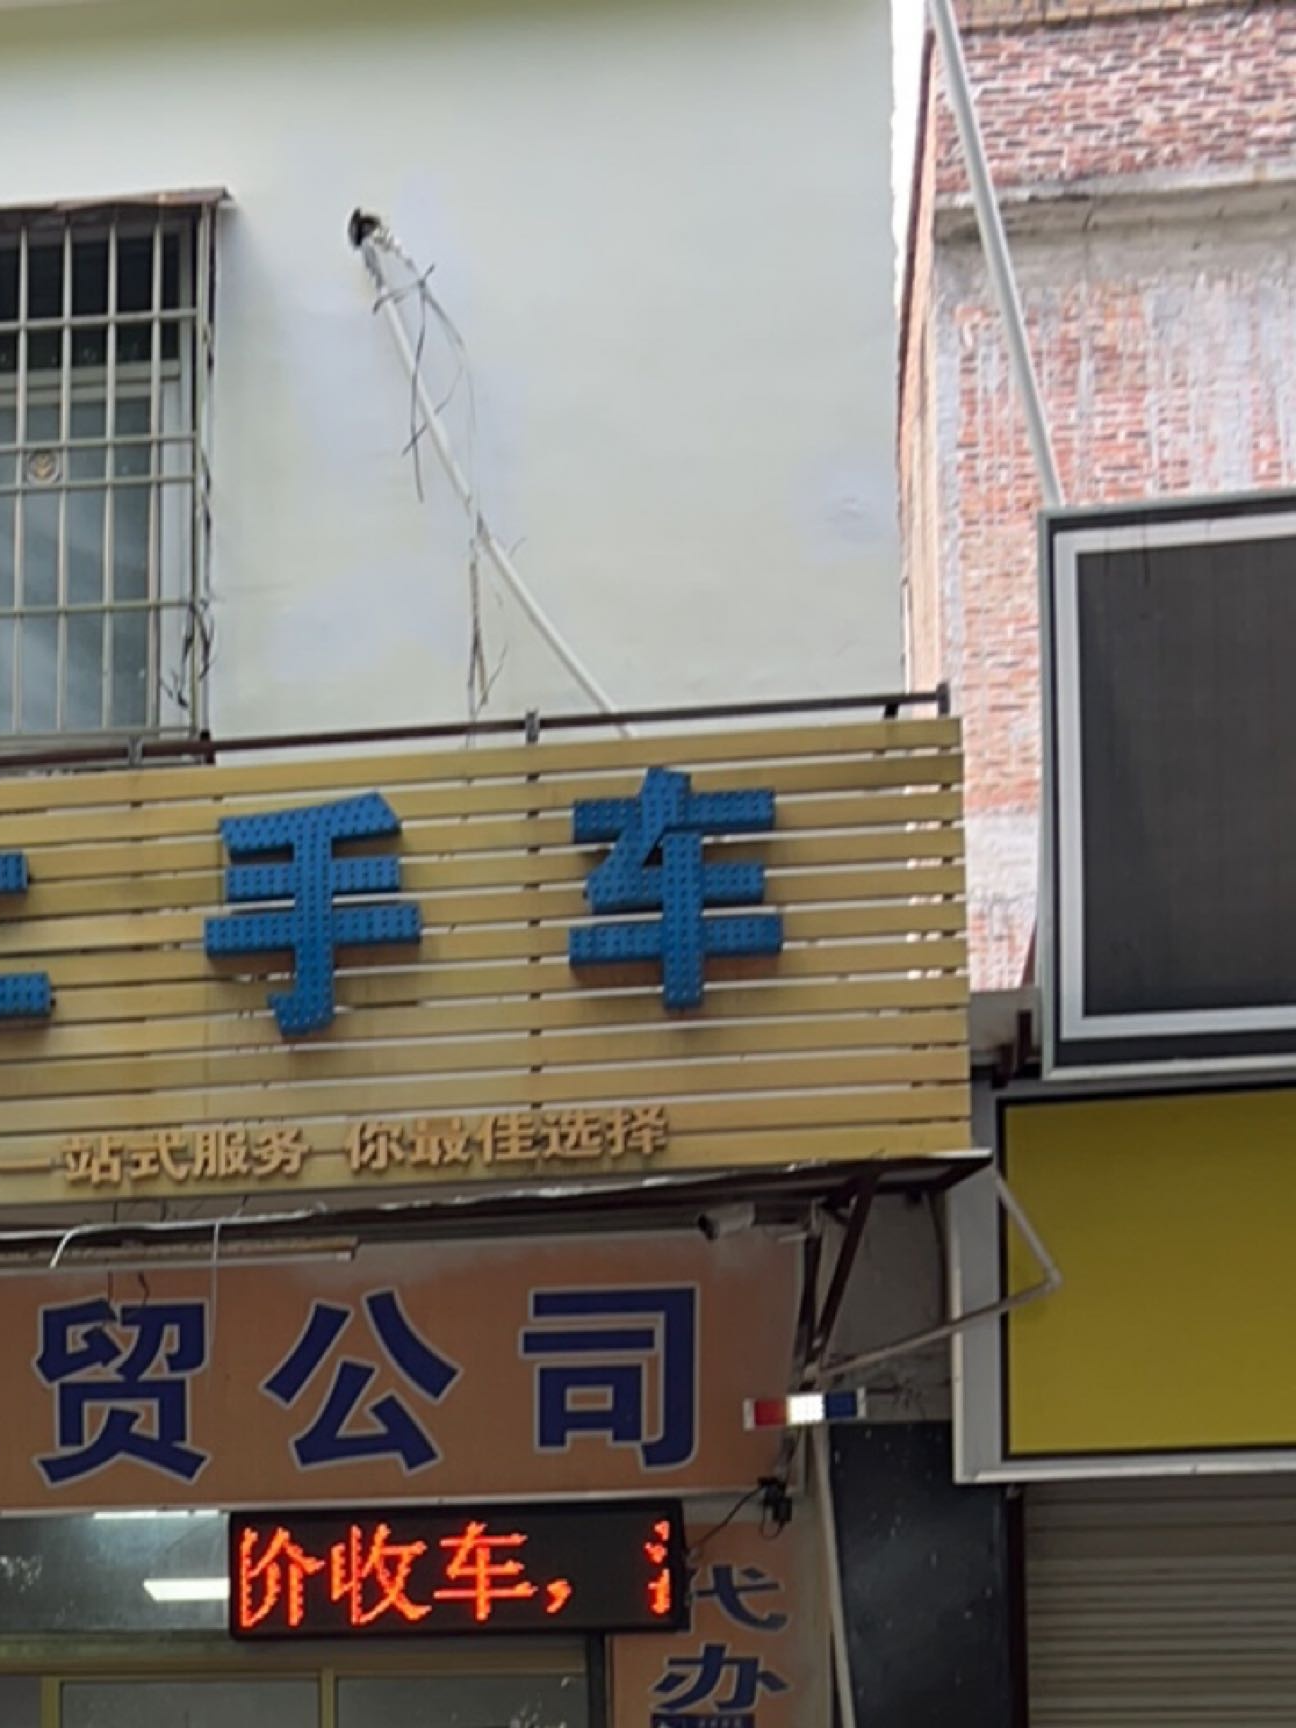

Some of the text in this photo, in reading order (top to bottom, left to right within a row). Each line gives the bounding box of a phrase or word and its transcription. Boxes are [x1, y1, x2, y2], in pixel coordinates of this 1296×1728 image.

[344, 1103, 671, 1174] 你最佳选择
